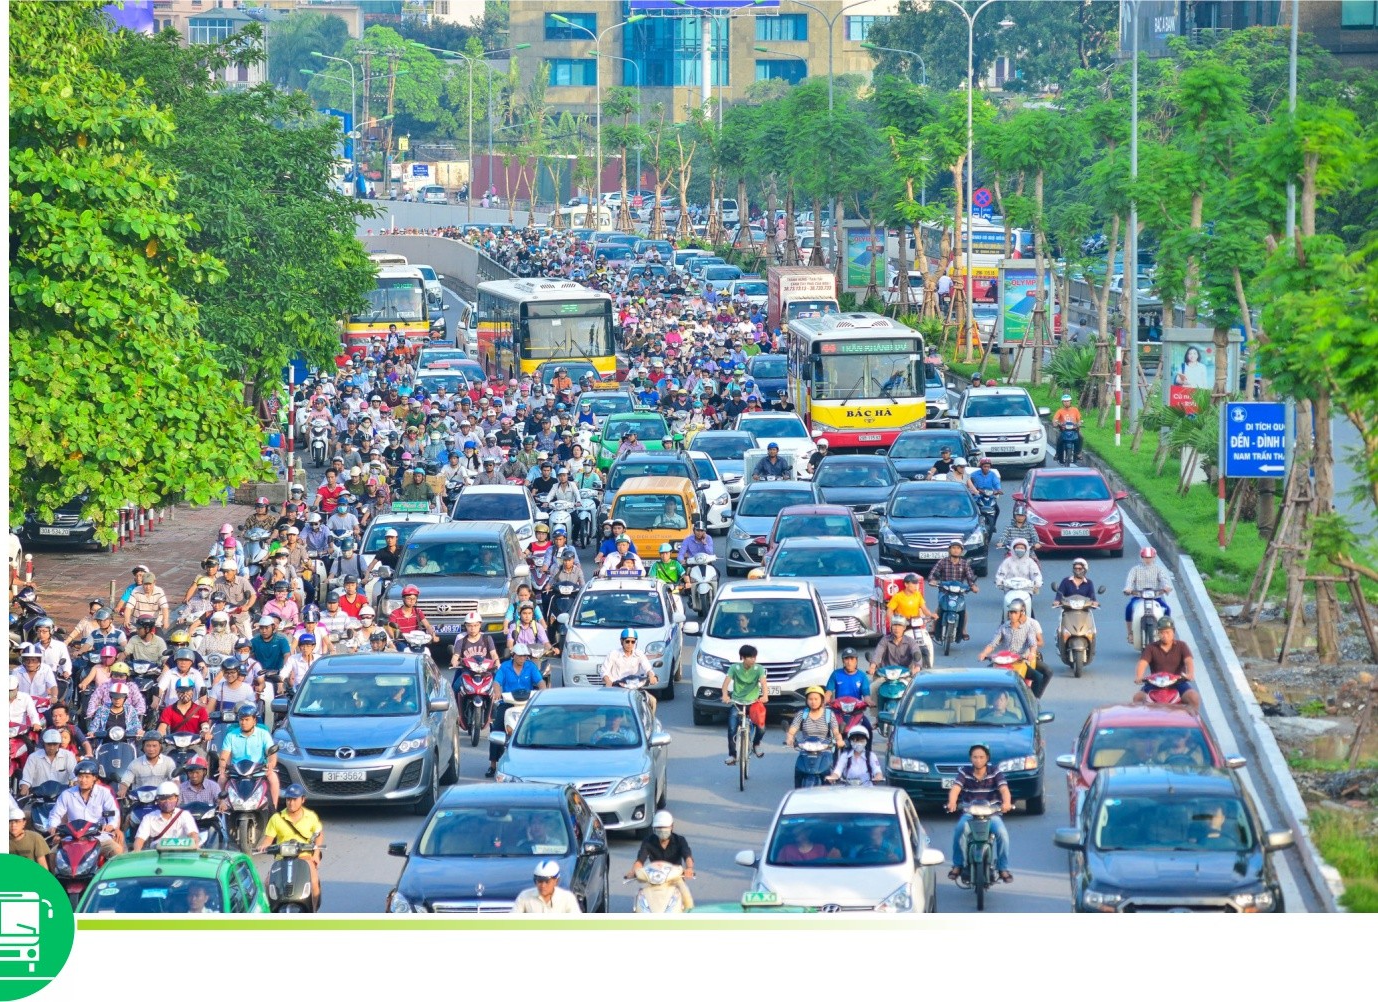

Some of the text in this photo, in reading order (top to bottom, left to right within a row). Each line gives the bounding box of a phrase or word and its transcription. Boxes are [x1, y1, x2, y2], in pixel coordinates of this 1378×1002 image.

[846, 407, 892, 417] BẮC HÀ
[1255, 422, 1271, 430] TÍCH
[1257, 433, 1280, 448] ĐÌNH
[1253, 451, 1272, 460] TRẤN
[328, 772, 362, 781] 31F-3562
